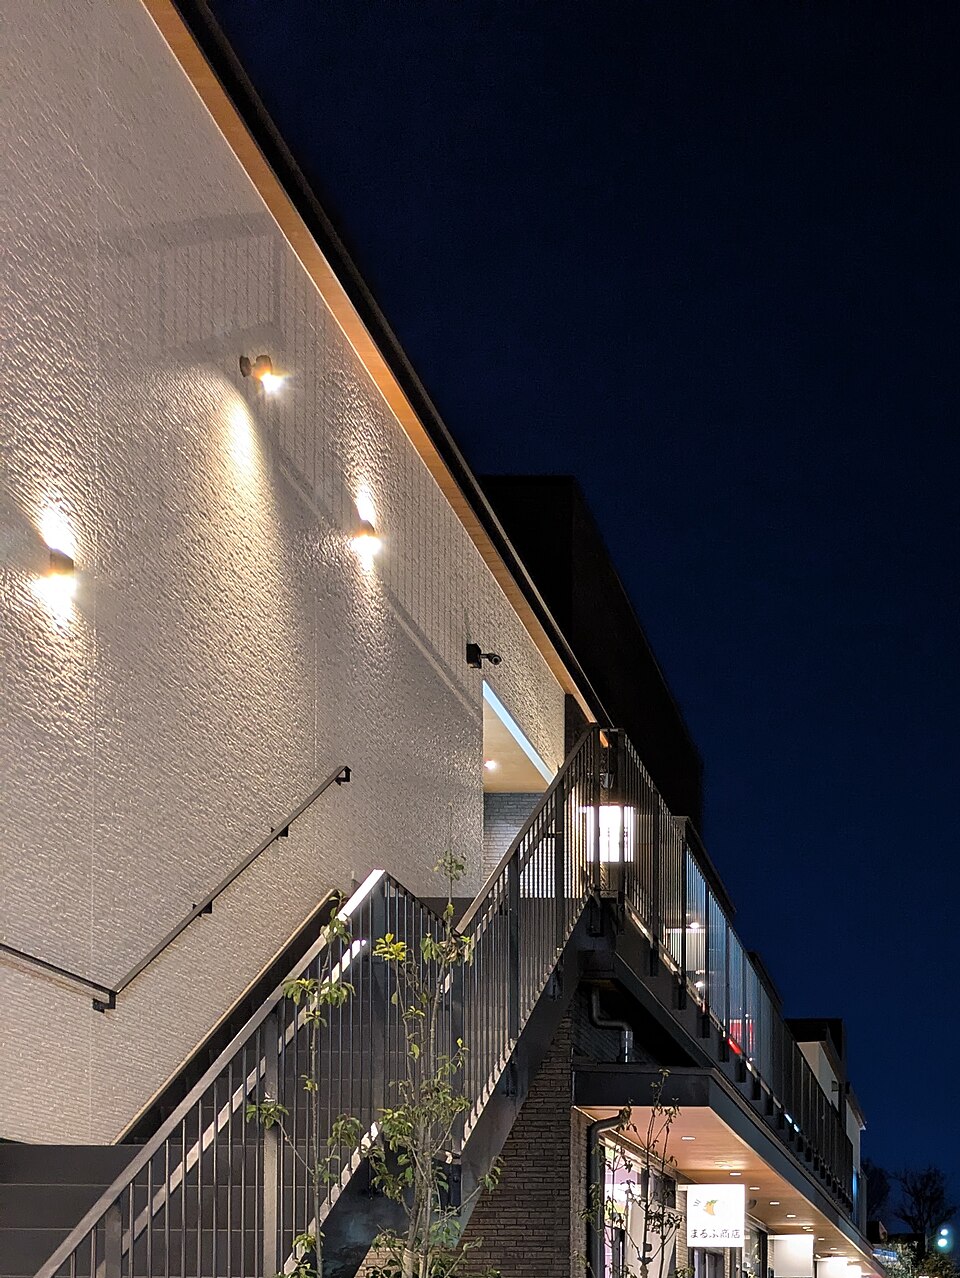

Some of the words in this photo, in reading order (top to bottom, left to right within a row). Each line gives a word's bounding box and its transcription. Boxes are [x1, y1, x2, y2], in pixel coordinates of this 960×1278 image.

[690, 1229, 741, 1239] まるふ商店
